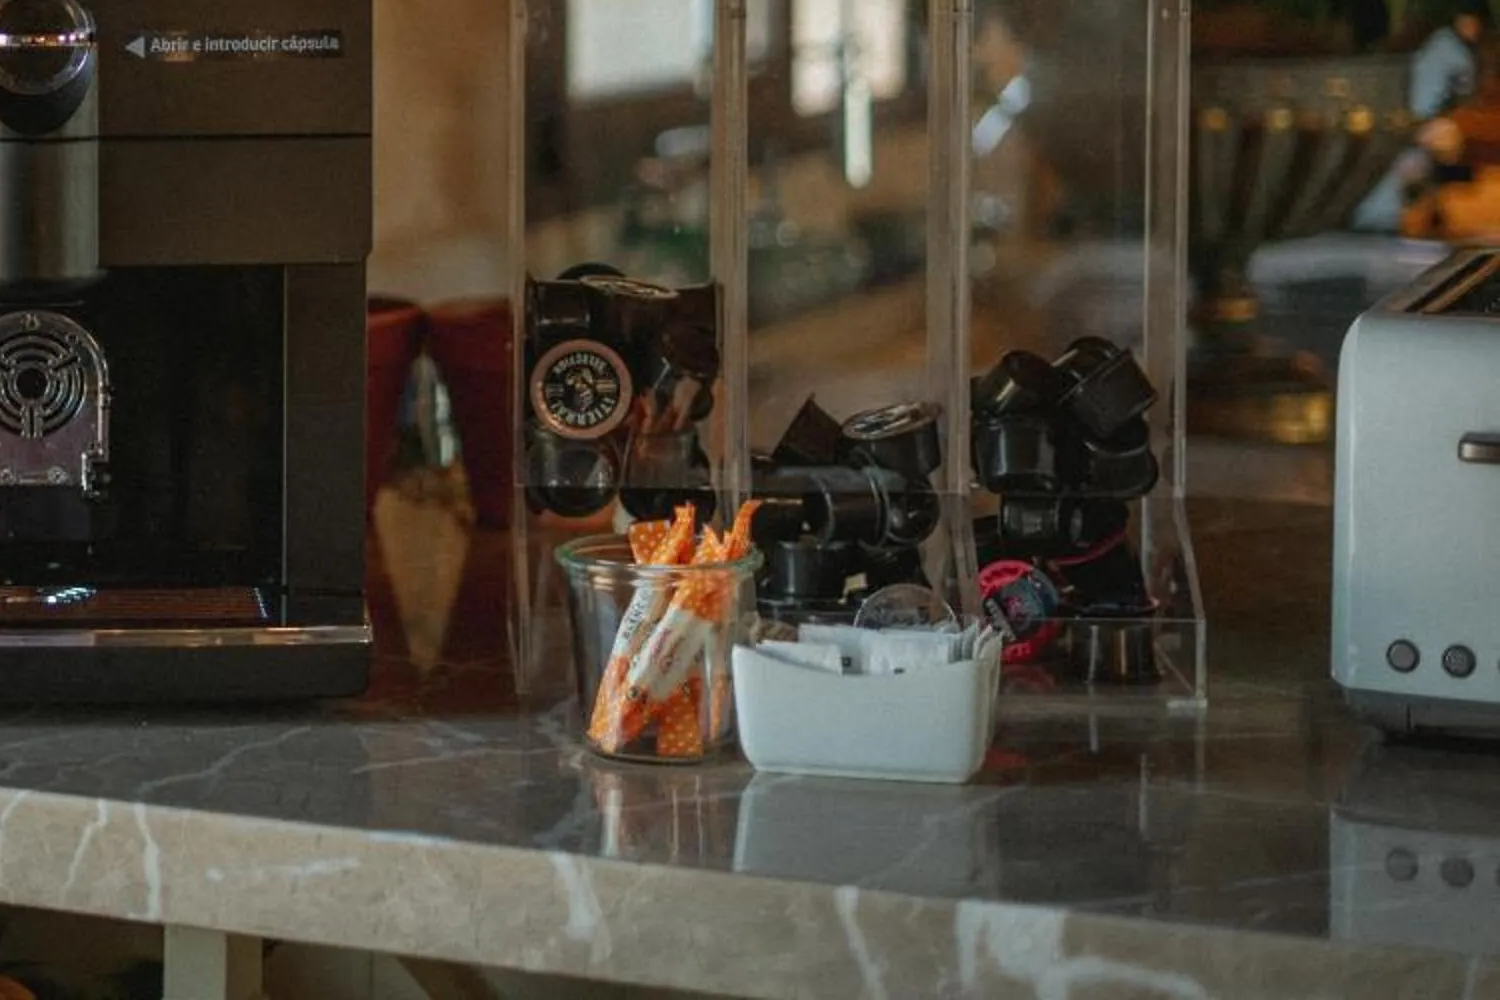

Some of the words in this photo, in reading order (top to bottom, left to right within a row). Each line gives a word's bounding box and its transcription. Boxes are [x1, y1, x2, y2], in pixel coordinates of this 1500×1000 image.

[151, 36, 188, 52] Abrir
[193, 42, 201, 51] e
[205, 35, 279, 52] introducir
[281, 35, 340, 53] cápsula
